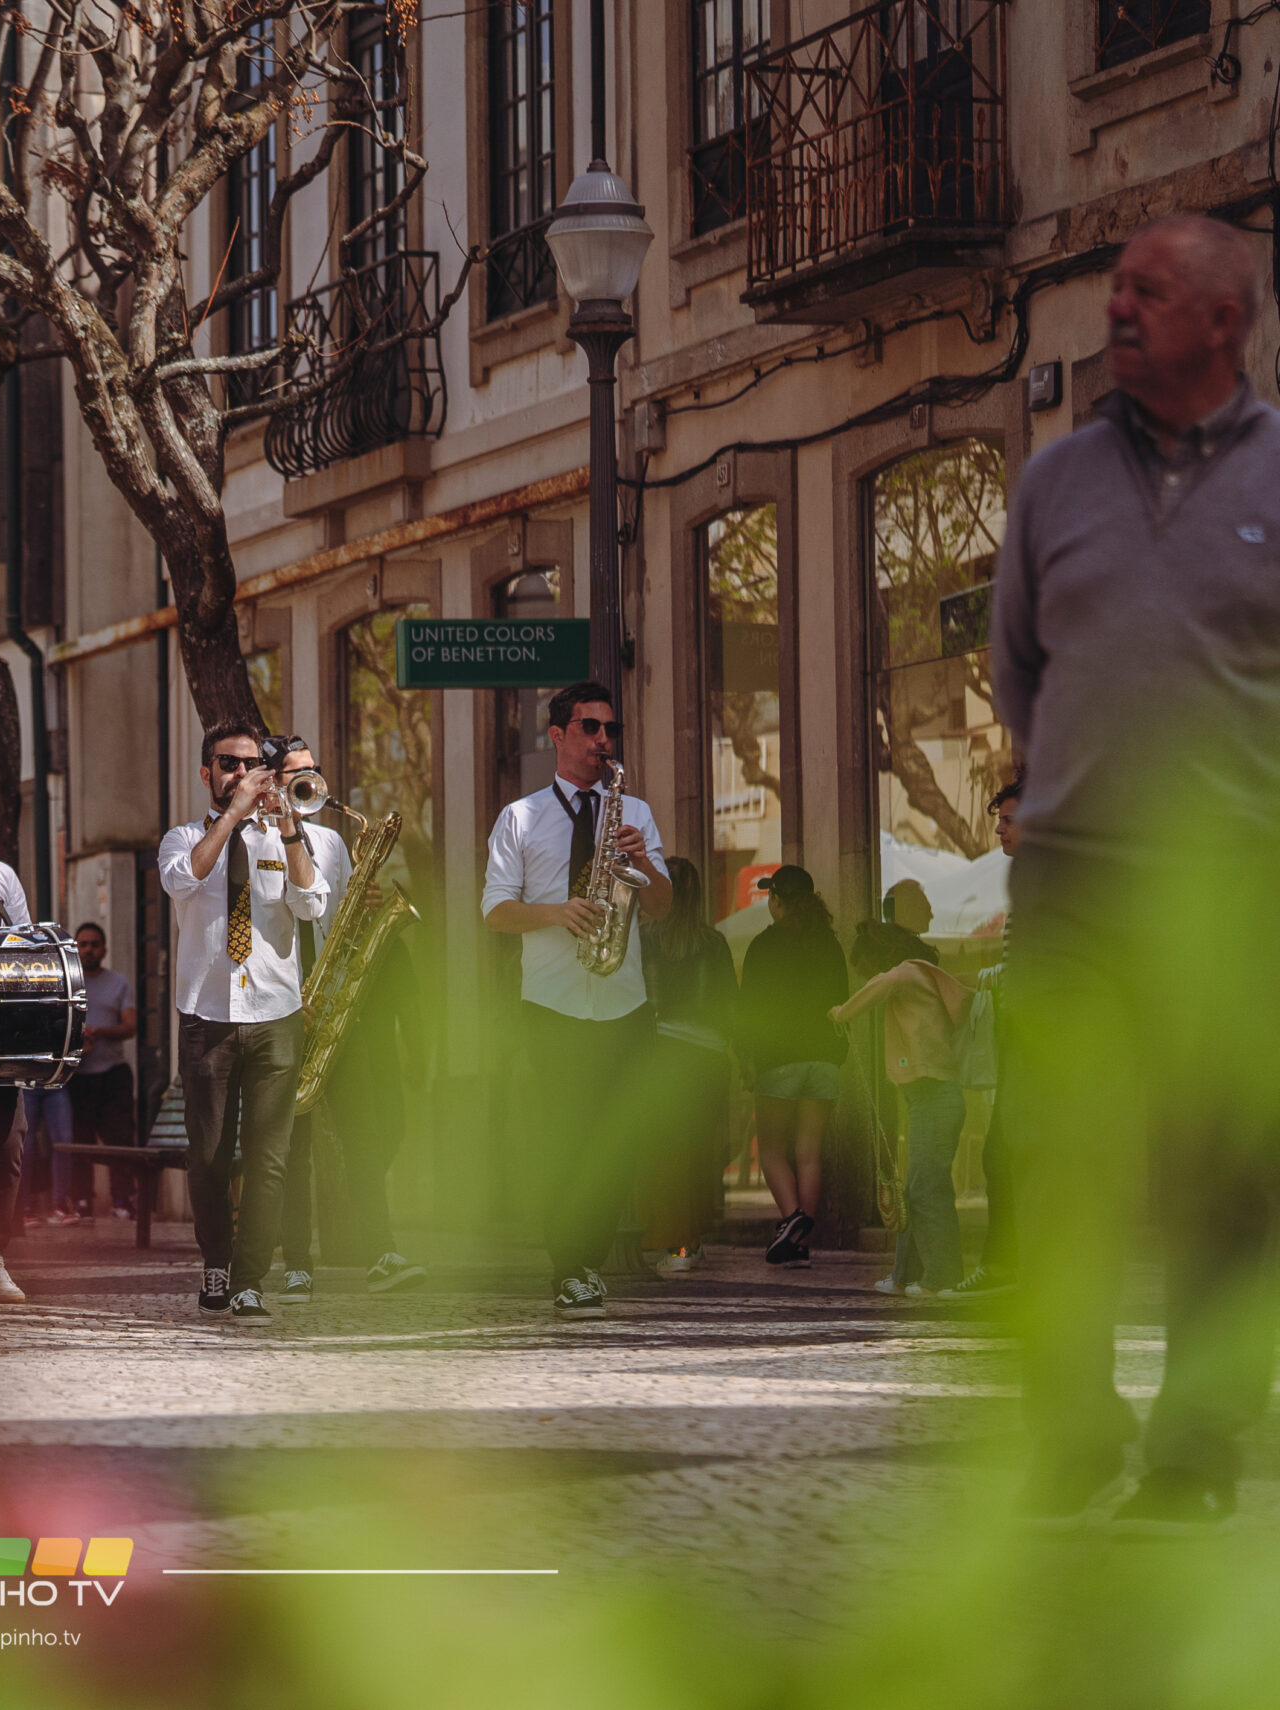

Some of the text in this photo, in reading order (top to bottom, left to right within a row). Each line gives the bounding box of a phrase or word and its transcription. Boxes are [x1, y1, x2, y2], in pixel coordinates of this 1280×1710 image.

[411, 626, 556, 643] UNITED COLORS
[411, 646, 541, 663] OF BENETTON.
